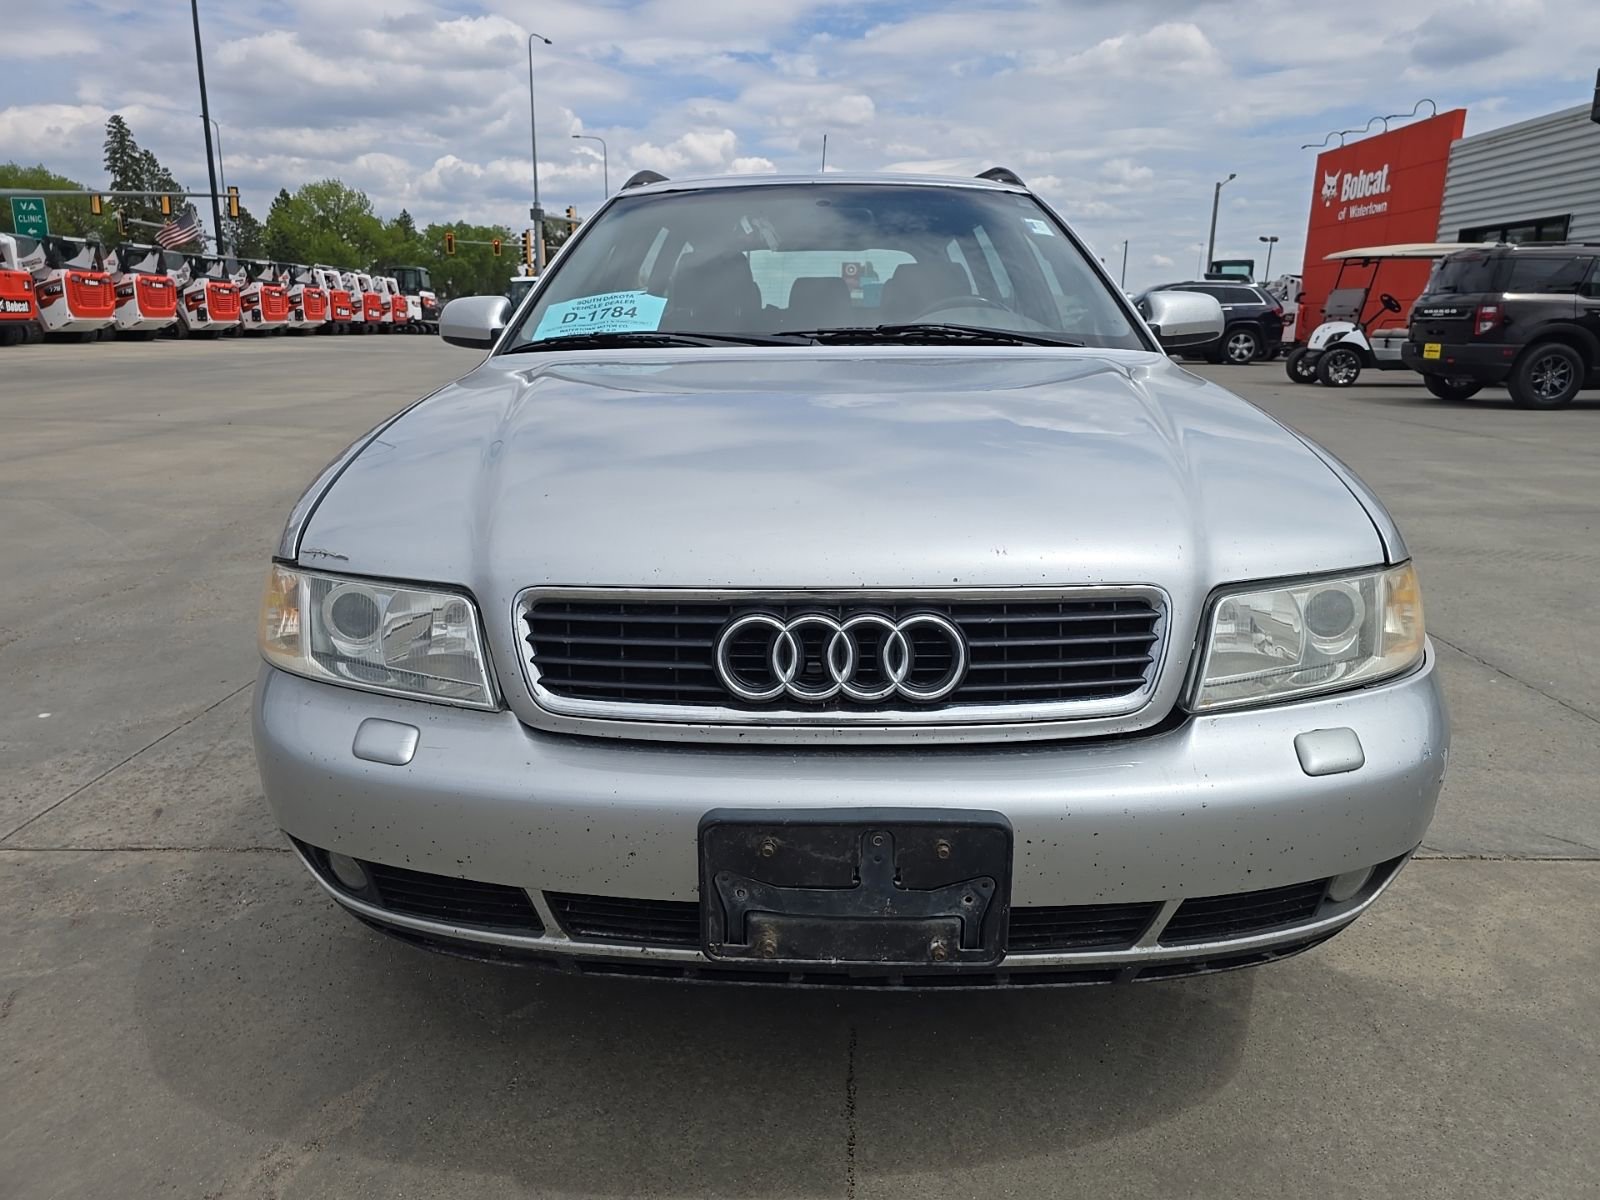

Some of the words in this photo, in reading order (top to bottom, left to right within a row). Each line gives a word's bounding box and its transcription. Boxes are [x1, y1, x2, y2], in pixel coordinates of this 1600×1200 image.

[1340, 163, 1389, 202] Bobcat
[20, 202, 37, 210] VA
[1338, 207, 1347, 220] of
[1349, 202, 1388, 218] Watertown
[18, 214, 43, 223] CLINIC
[5, 300, 29, 312] Bobcat
[572, 303, 602, 311] VEHICLE
[604, 299, 635, 307] DEALER
[561, 306, 638, 324] D-1784
